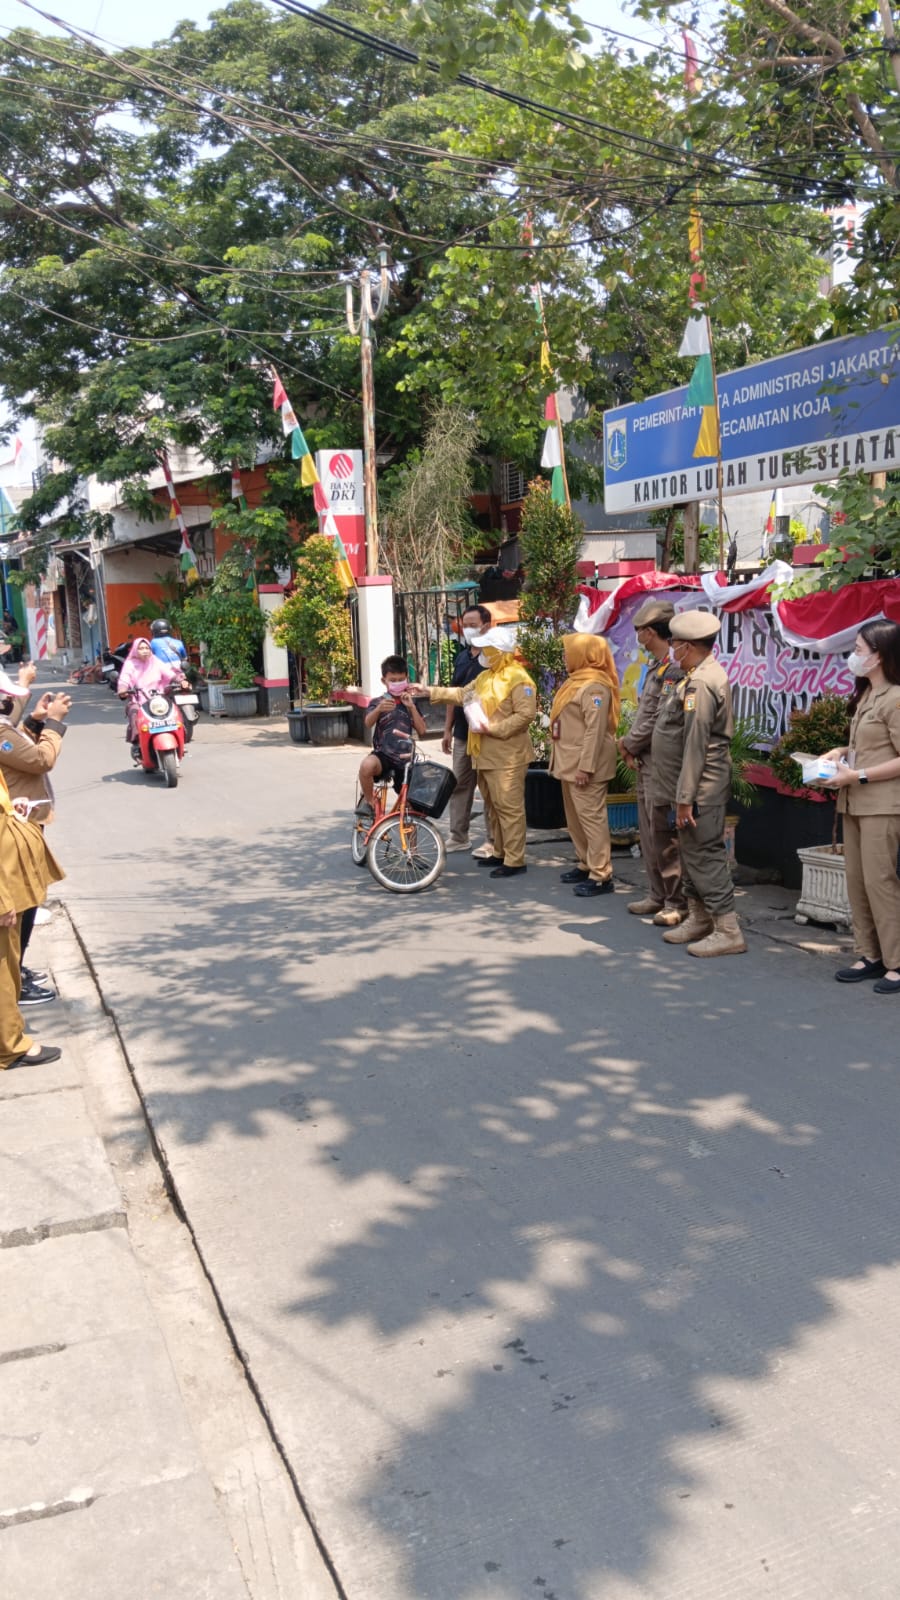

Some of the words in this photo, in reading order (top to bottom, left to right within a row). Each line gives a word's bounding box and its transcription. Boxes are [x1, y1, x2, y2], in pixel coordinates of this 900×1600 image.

[633, 405, 696, 432] PEMERINTAH
[733, 365, 823, 406] ADMINISTRASI
[829, 343, 900, 379] JAKARTA
[793, 396, 831, 420] KOJA
[330, 489, 357, 501] DKI
[634, 473, 687, 503] KANTOR
[343, 543, 360, 555] TM
